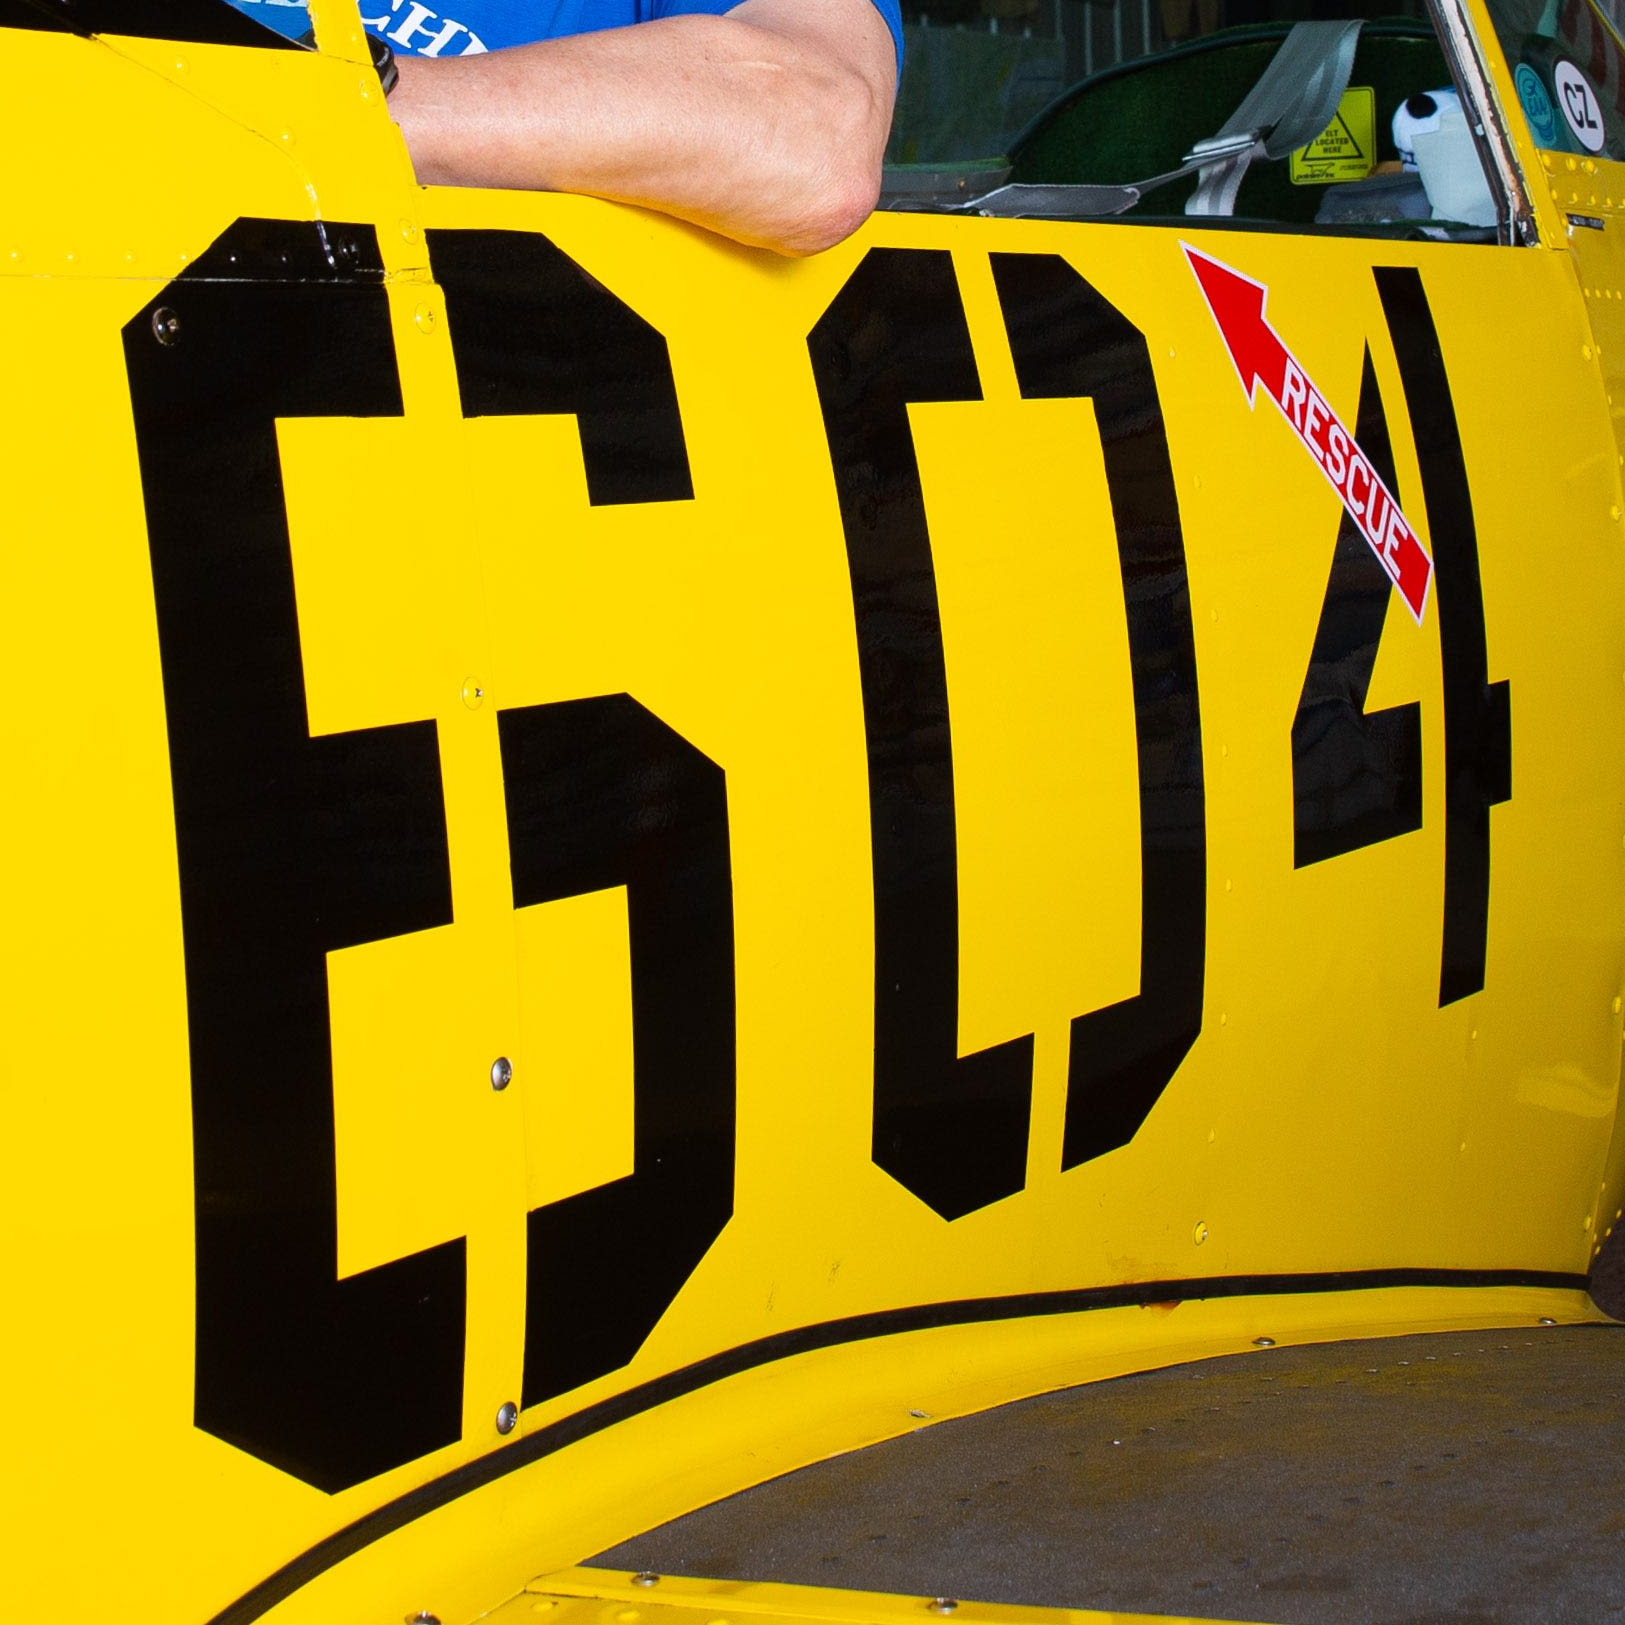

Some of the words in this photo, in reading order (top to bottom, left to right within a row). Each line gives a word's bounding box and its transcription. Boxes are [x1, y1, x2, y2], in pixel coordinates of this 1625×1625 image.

[1315, 137, 1350, 146] LOCATED
[1563, 81, 1598, 129] CZ
[1281, 357, 1409, 581] RESCUE
[120, 215, 1512, 1495] 604
